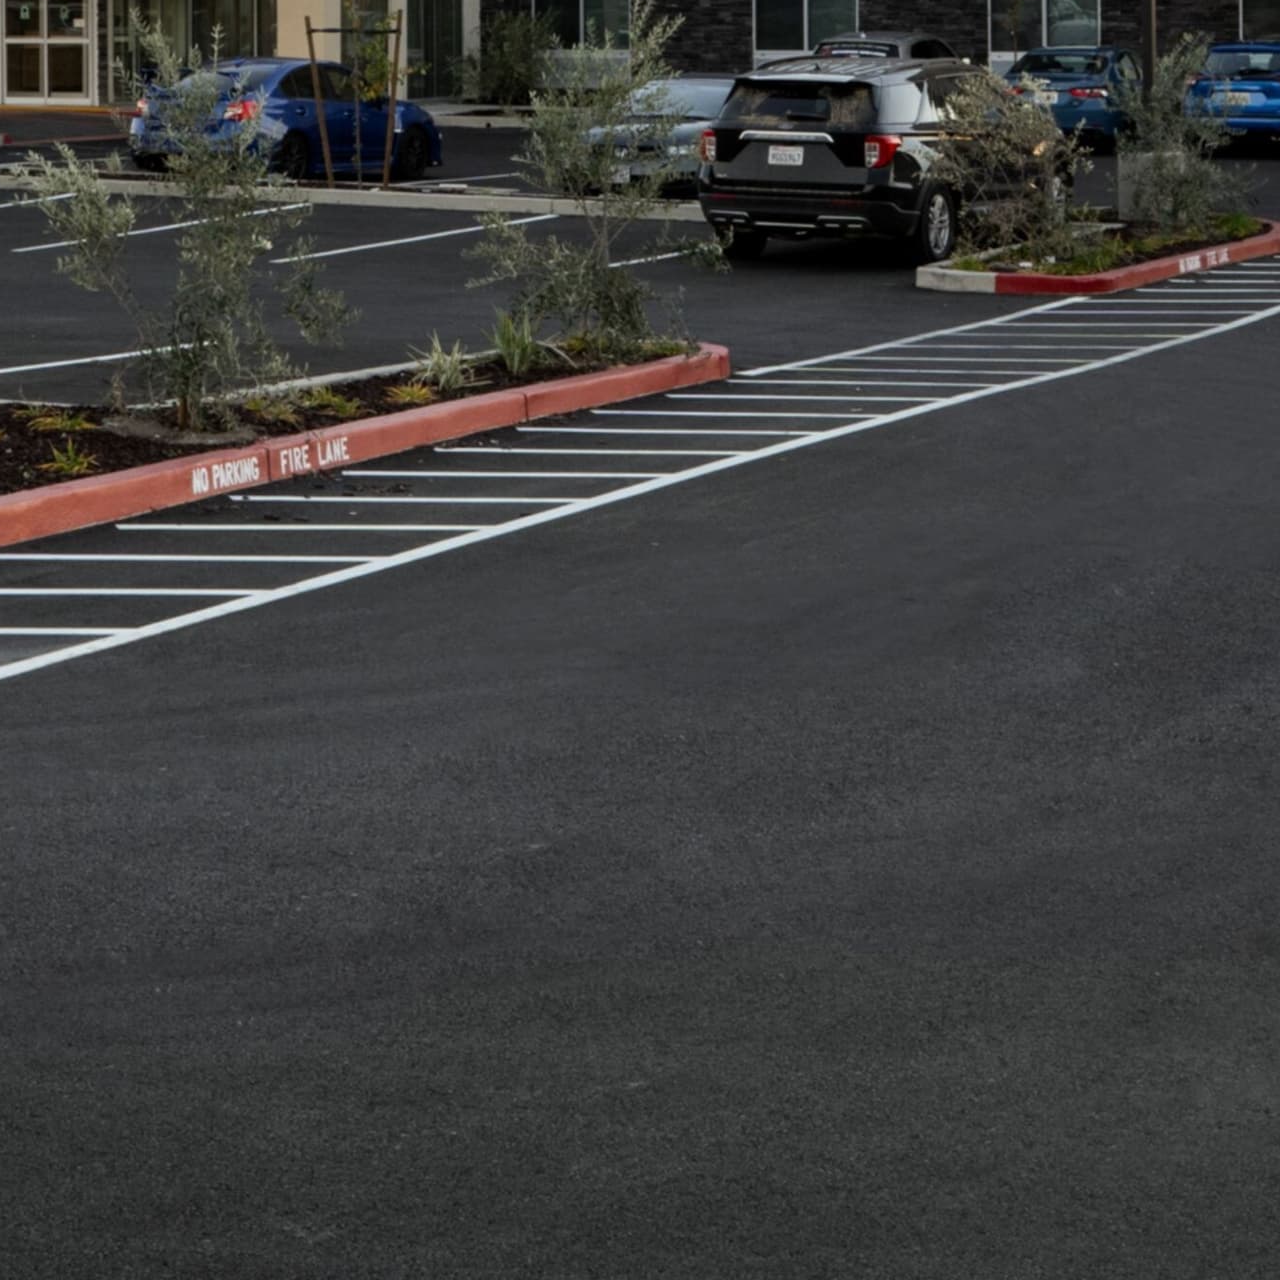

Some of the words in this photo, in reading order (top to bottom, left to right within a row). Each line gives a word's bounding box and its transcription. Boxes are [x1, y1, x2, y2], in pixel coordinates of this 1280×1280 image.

[192, 465, 209, 495] NO
[212, 455, 261, 489] PARKING
[280, 444, 311, 475] FIRE
[317, 437, 351, 468] LANE
